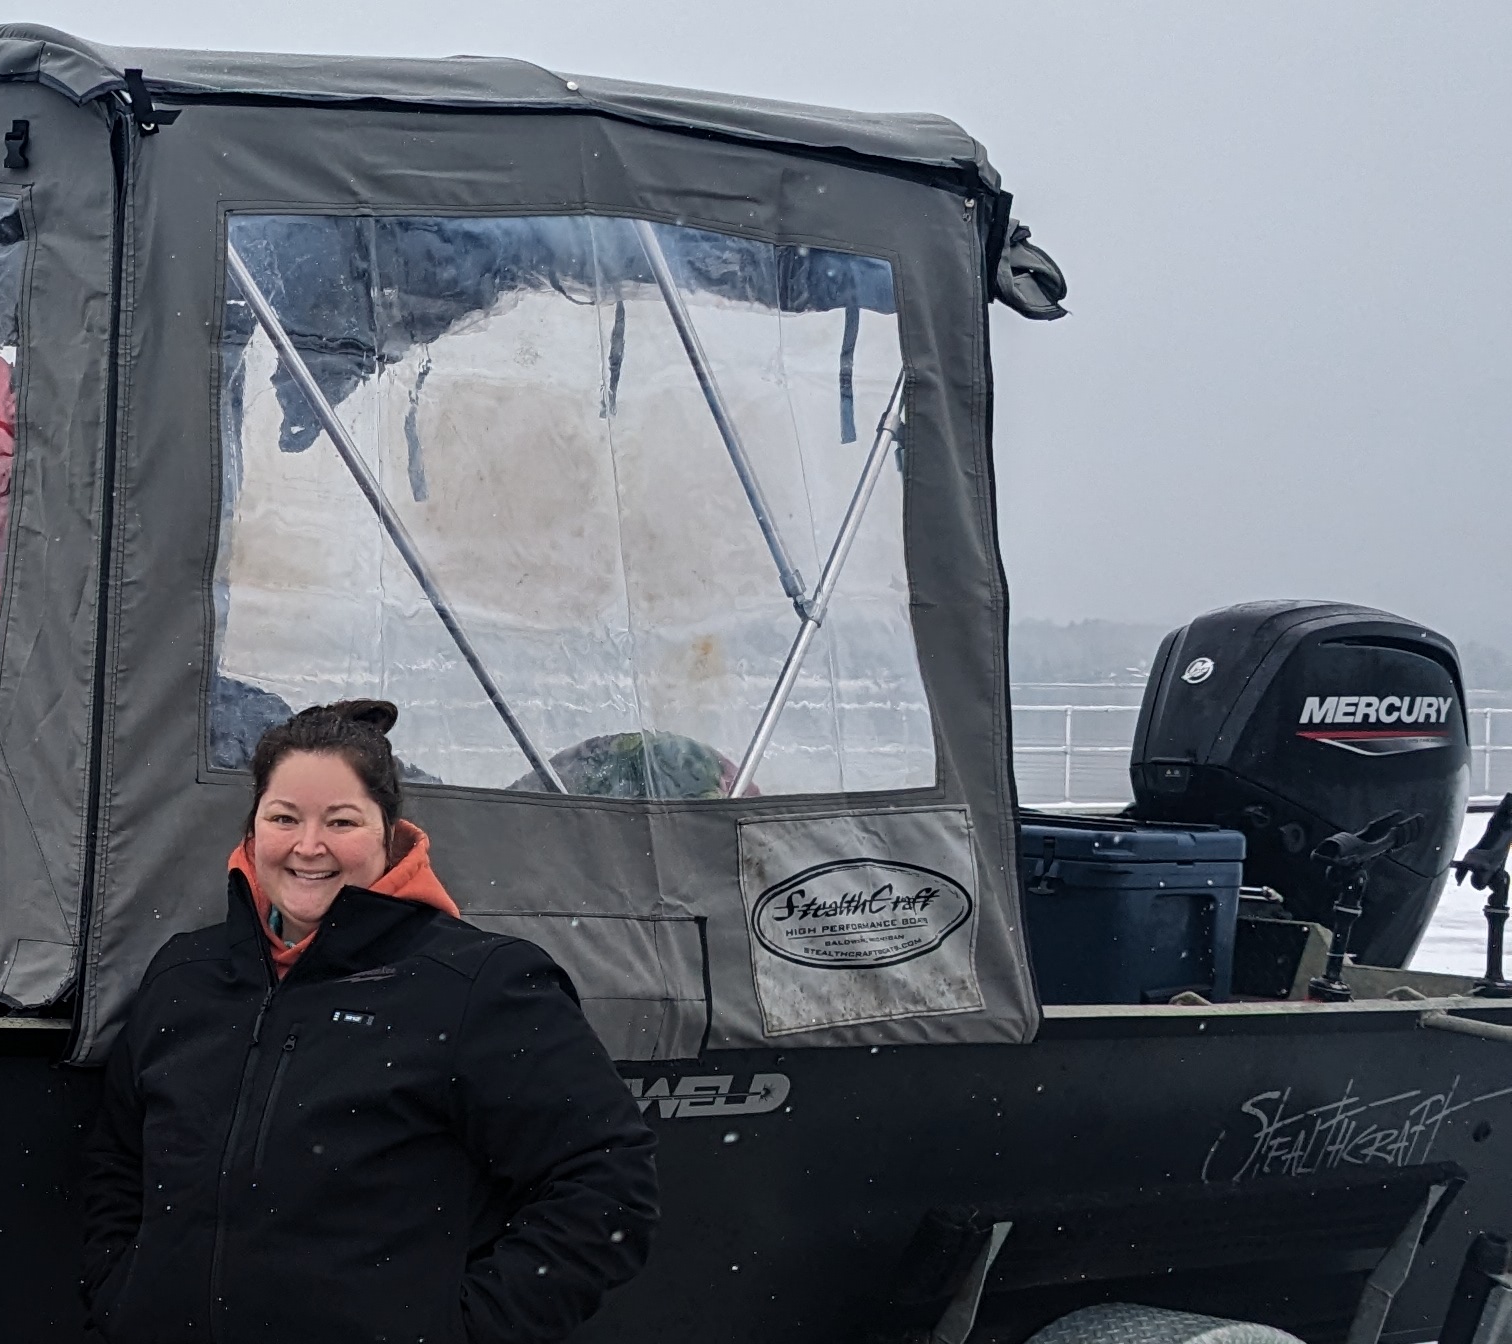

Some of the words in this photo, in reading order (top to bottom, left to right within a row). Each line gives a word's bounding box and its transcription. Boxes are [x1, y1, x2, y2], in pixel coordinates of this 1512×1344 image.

[1299, 696, 1453, 725] MERCURY
[786, 927, 817, 937] HIGH
[821, 919, 897, 934] PERFORMANCE
[623, 1073, 791, 1119] WELD
